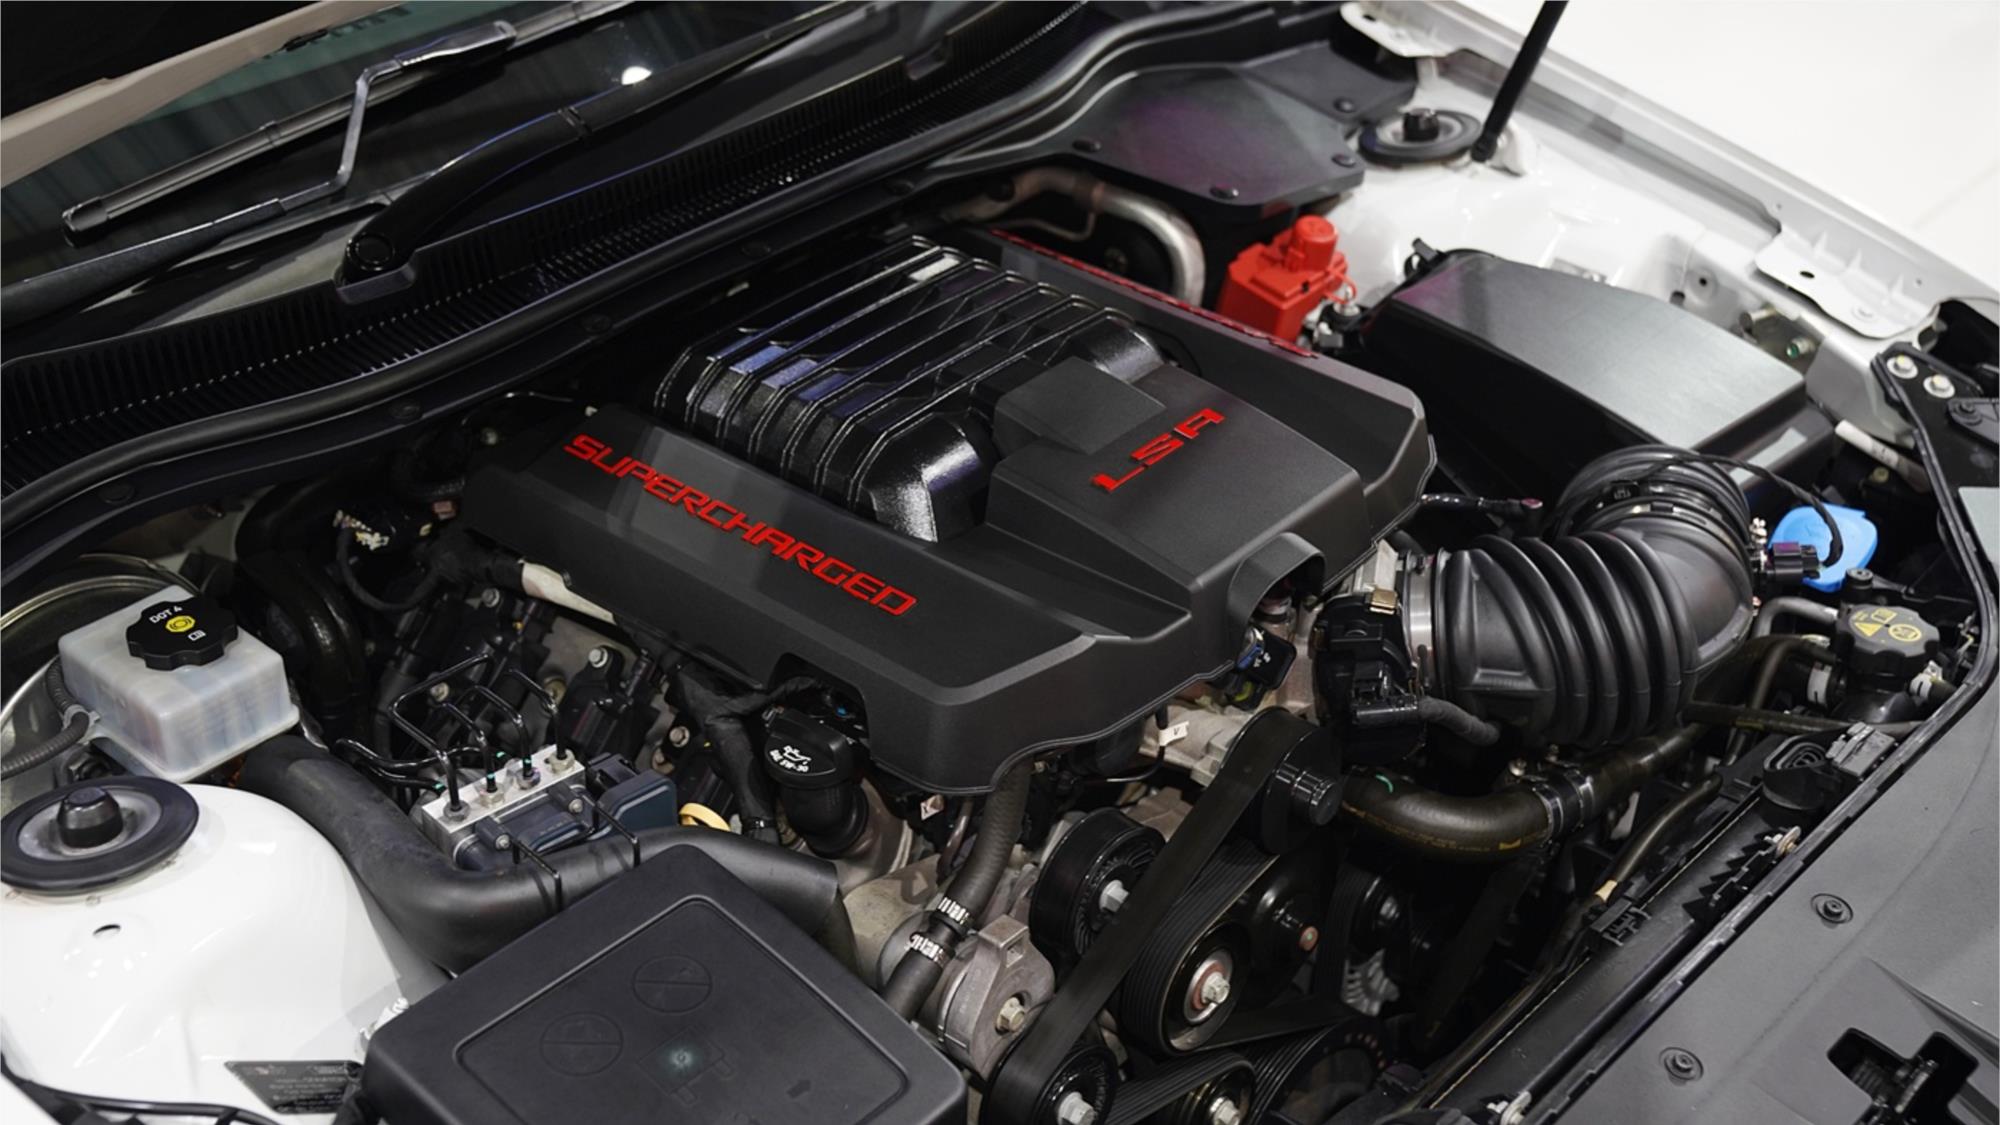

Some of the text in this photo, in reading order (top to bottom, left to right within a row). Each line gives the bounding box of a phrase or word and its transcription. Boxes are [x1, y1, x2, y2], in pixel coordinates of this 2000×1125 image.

[1090, 407, 1225, 492] LSA
[563, 433, 917, 616] SUPERCHARGED
[149, 605, 183, 624] DOT 4
